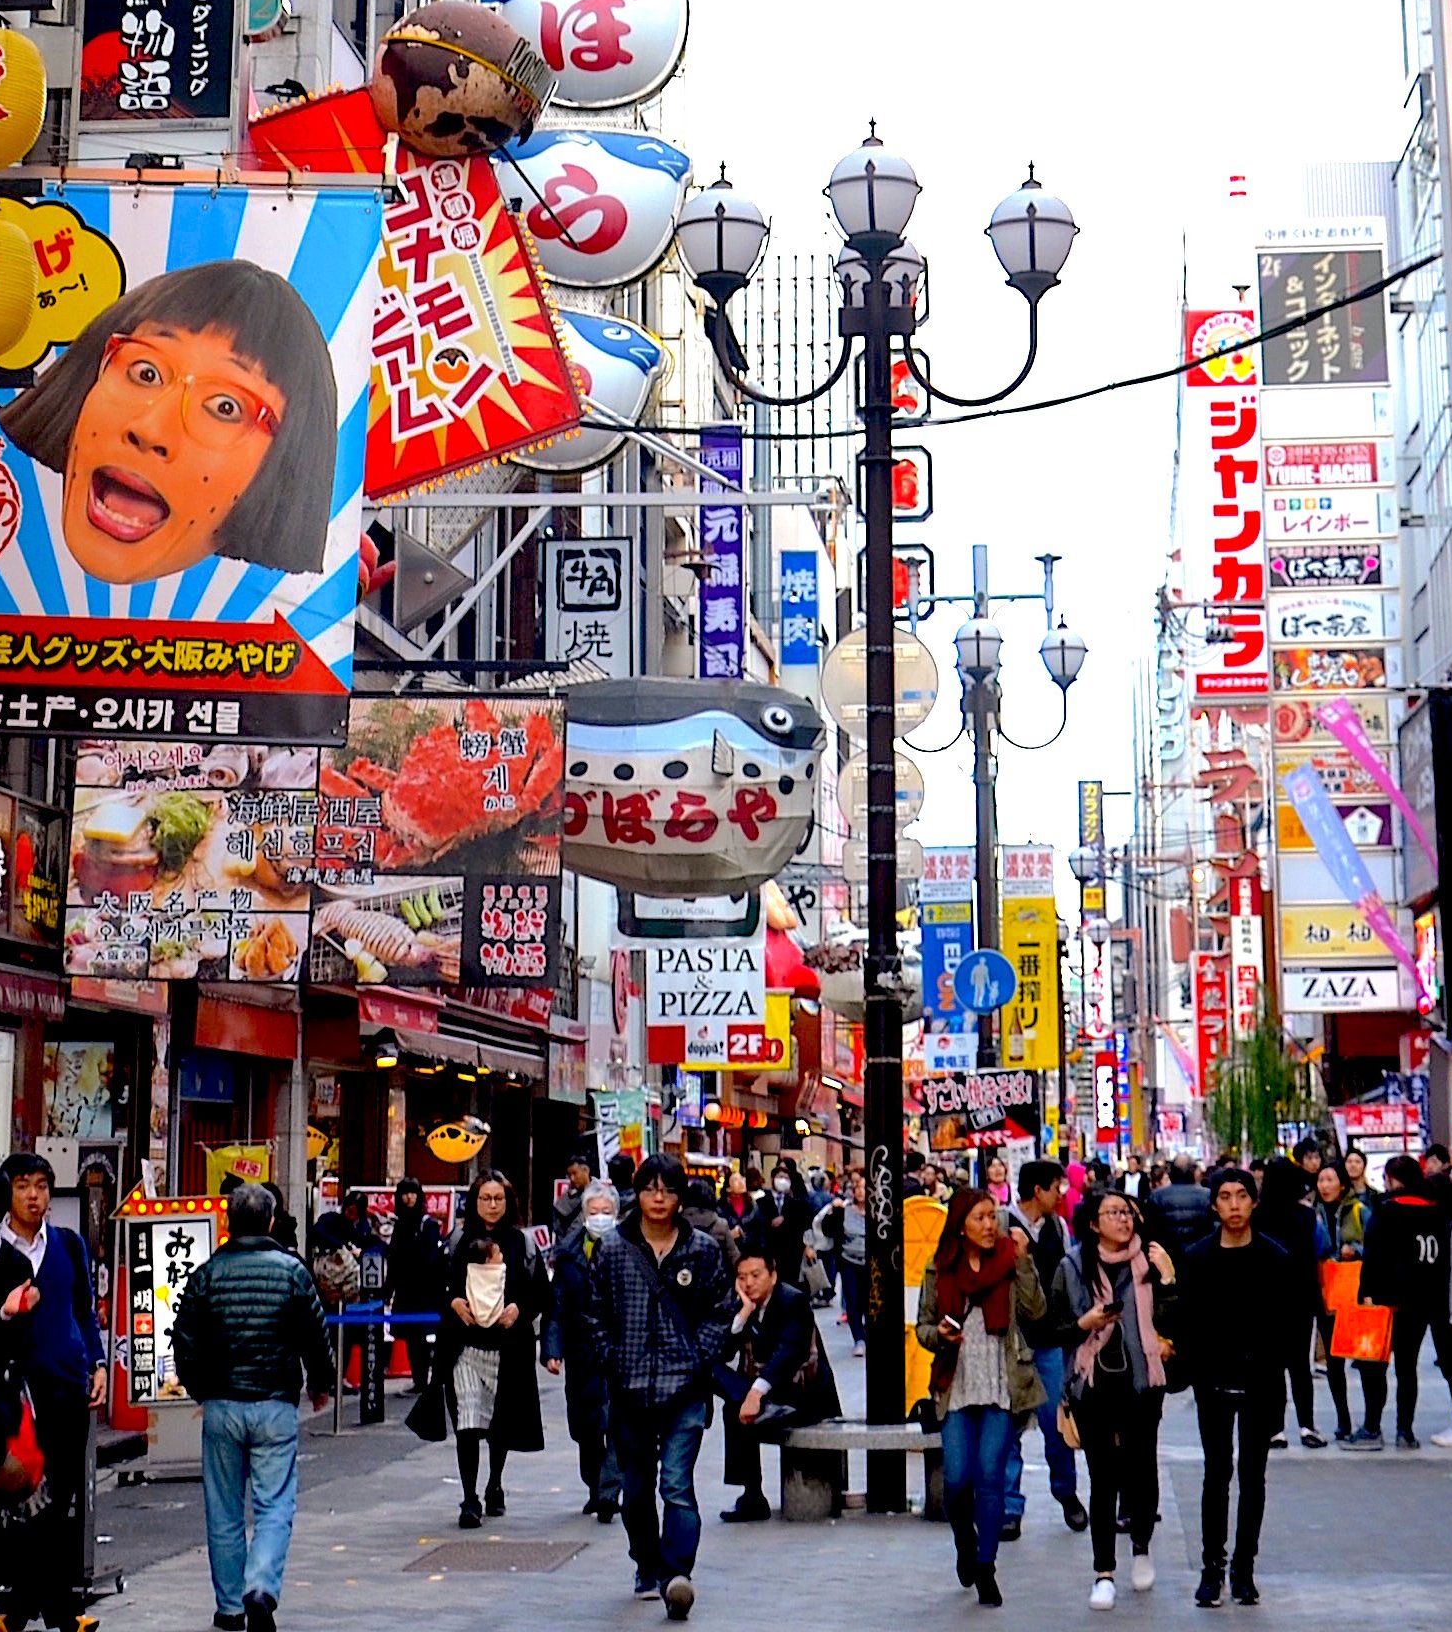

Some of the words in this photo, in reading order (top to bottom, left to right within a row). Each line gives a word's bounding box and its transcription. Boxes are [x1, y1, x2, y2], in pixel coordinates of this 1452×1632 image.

[1209, 395, 1265, 668] ジャンカラ
[566, 561, 615, 597] 牛角
[781, 570, 817, 647] 焼肉
[186, 696, 241, 735] 선물
[482, 765, 509, 792] 게
[656, 947, 758, 974] PASTA
[694, 975, 714, 990] &
[1302, 976, 1377, 998] ZAZA
[658, 991, 758, 1018] PIZZA
[729, 1033, 763, 1055] 2F
[1416, 1234, 1439, 1264] 10
